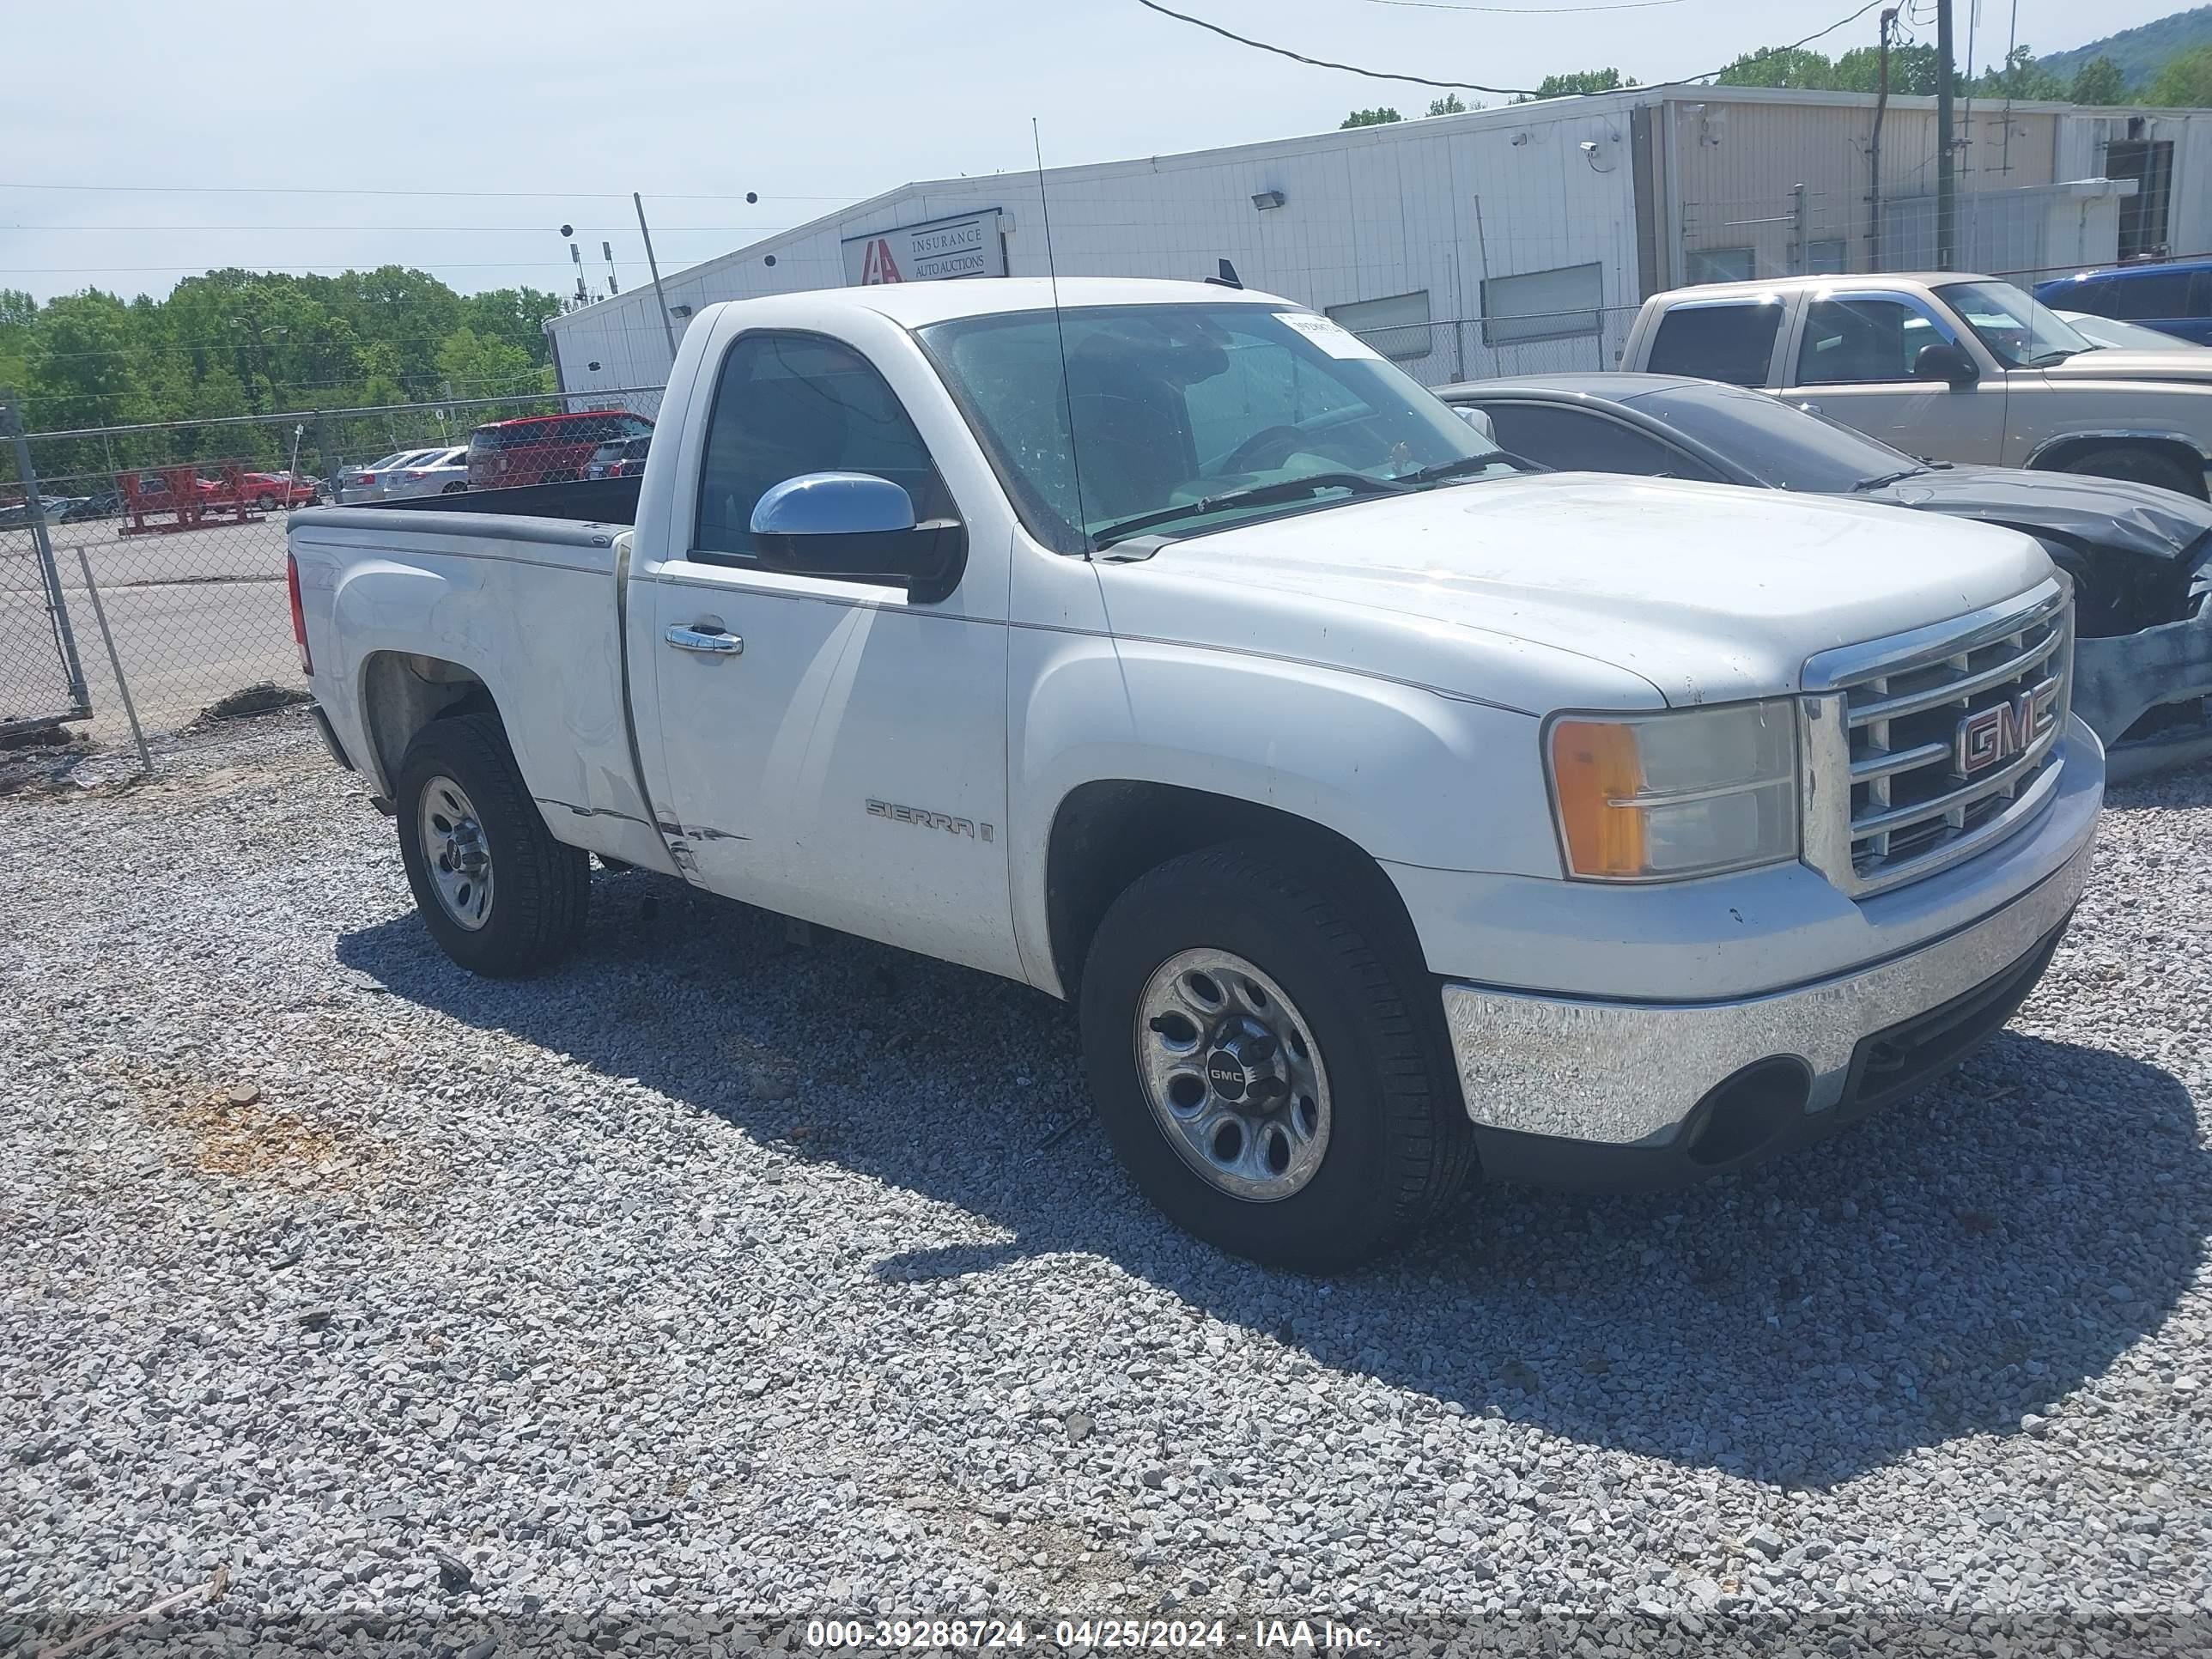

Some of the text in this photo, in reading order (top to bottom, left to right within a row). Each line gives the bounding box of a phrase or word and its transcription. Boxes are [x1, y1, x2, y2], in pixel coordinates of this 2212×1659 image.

[912, 228, 981, 252] INSURANCE
[915, 255, 984, 277] AUTO AUCTIONS
[1957, 675, 2061, 775] GMC
[865, 799, 975, 838] SIERRA
[1211, 1069, 1244, 1083] GMC
